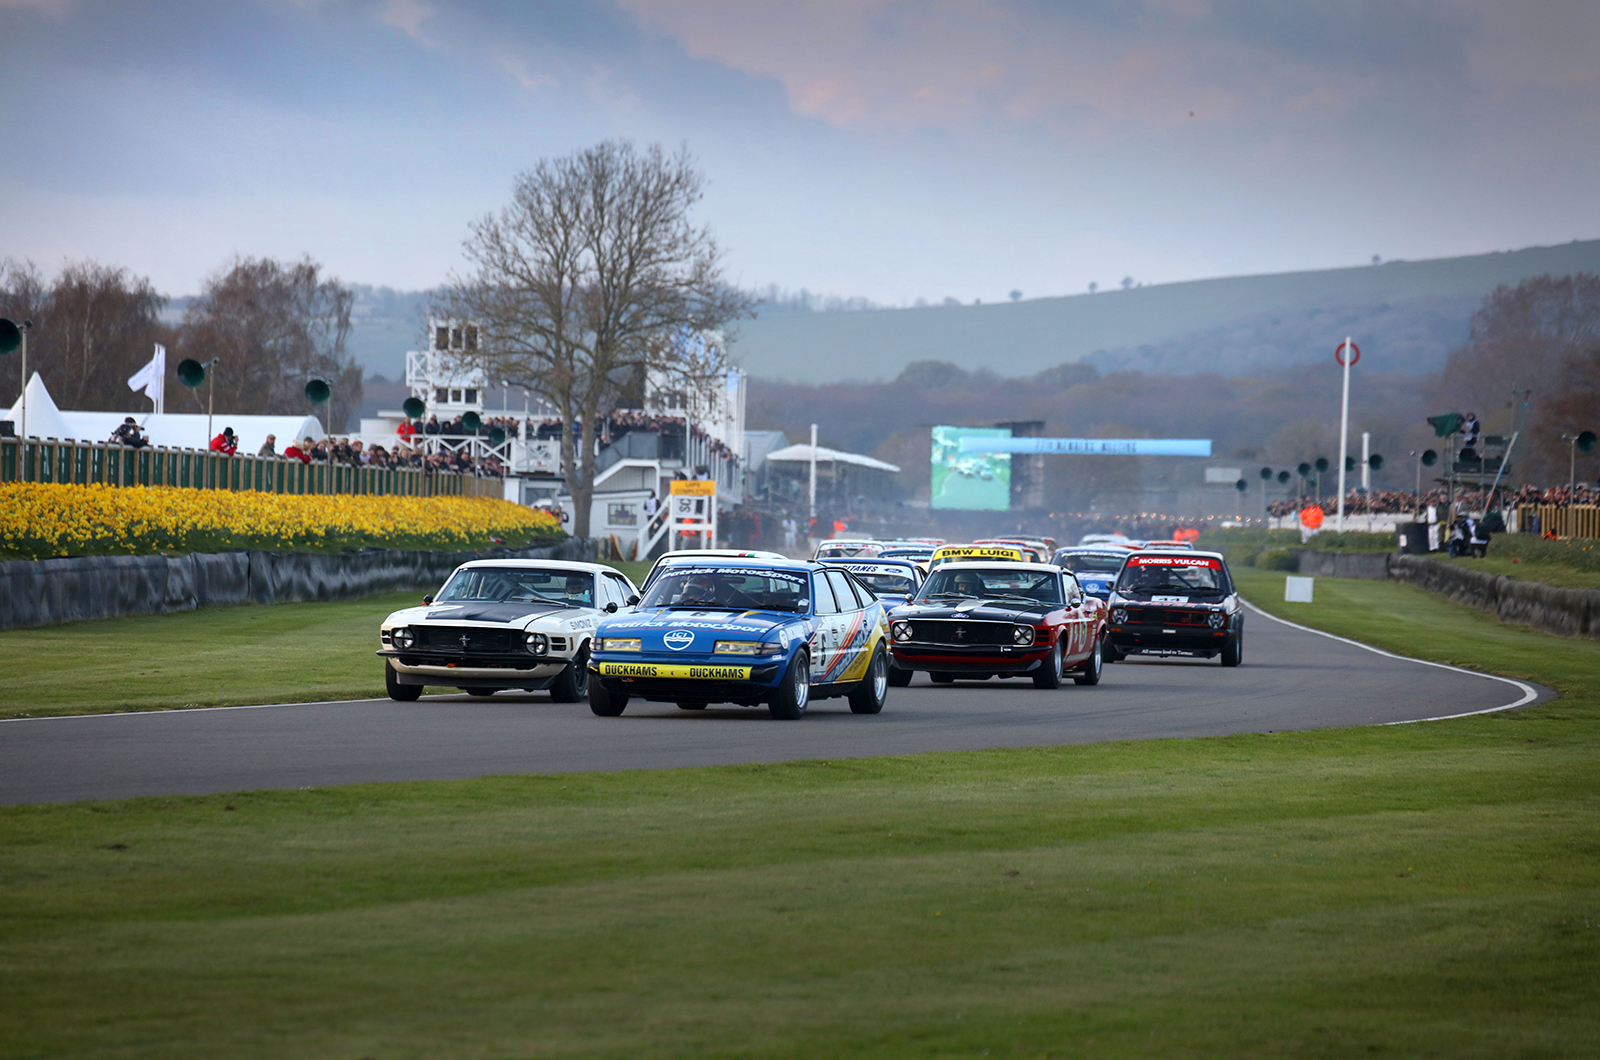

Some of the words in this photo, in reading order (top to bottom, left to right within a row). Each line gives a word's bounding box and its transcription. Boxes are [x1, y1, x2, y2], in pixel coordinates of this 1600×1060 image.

[942, 549, 974, 557] BMW
[980, 549, 1014, 557] LUIGI
[716, 568, 807, 585] MotorSport
[607, 621, 667, 629] Patrick
[668, 621, 769, 633] MotorSport
[604, 664, 658, 676] DUCKHAMS
[689, 667, 744, 679] DUCKHAMS
